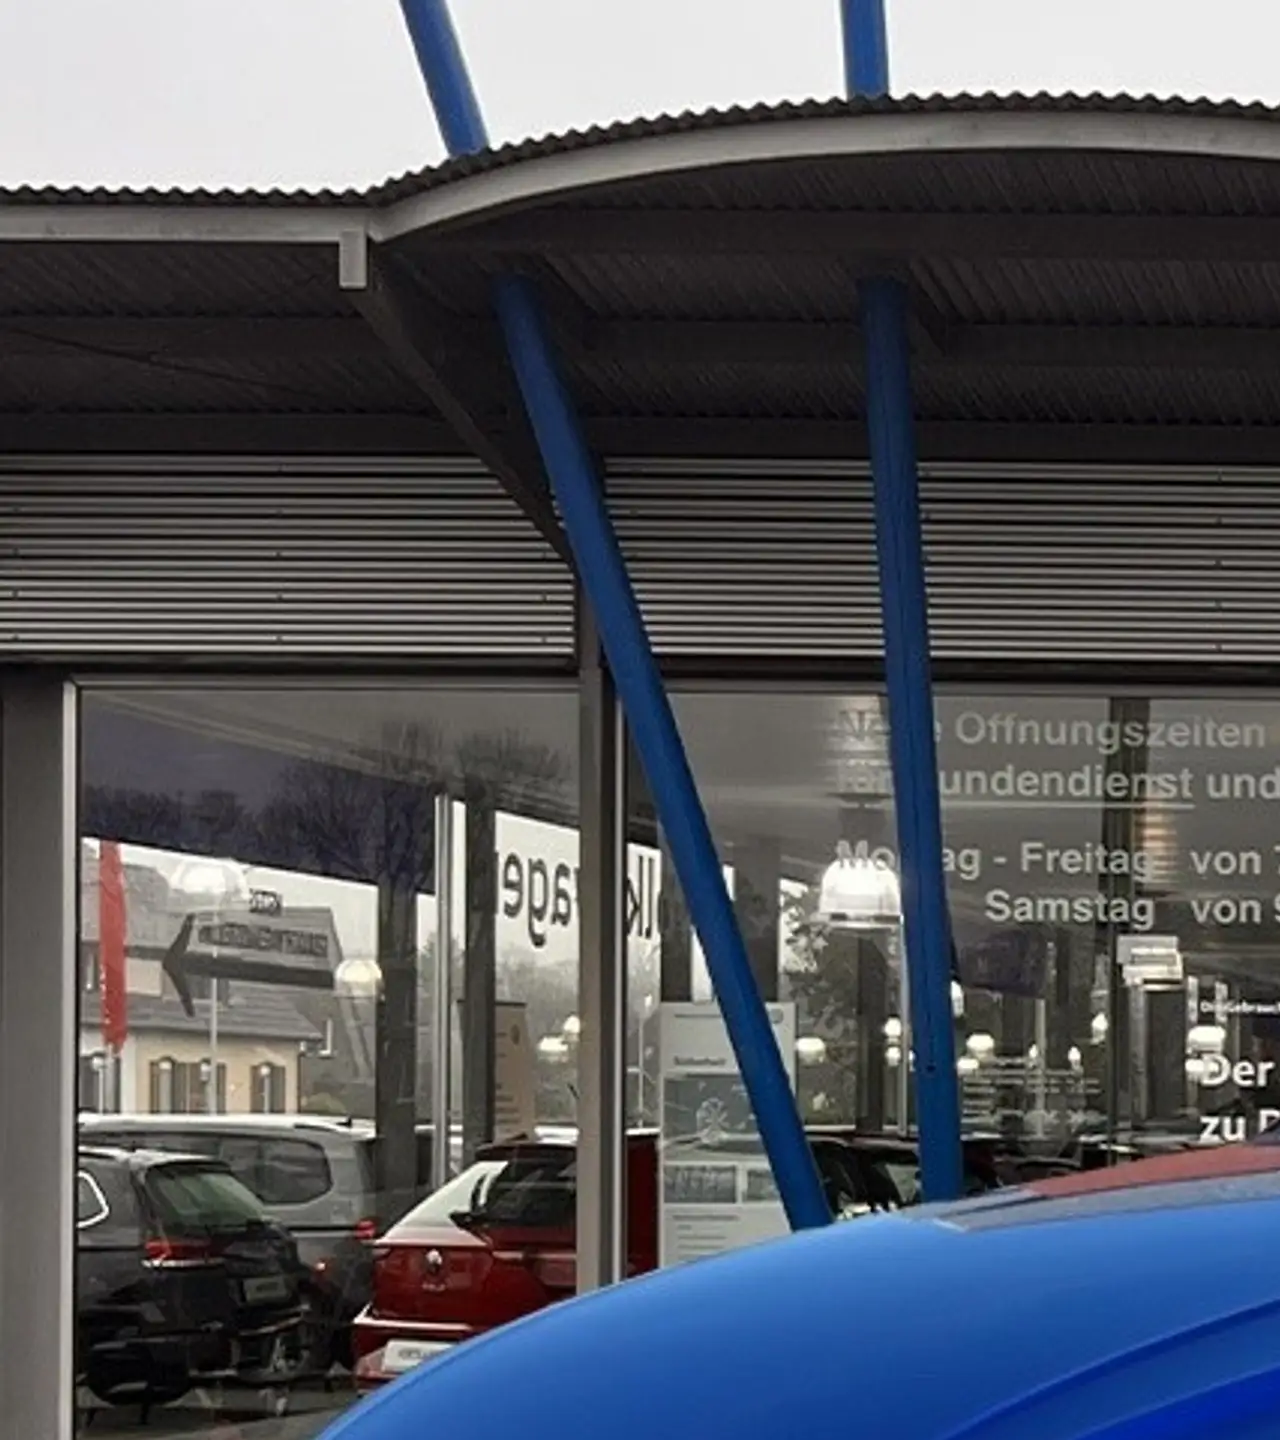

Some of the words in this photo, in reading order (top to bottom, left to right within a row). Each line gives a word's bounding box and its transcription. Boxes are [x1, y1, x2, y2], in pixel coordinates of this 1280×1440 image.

[937, 764, 1194, 797] undendienst
[836, 839, 982, 880] Moag
[1020, 840, 1155, 882] Freitag
[1190, 851, 1263, 878] von
[984, 889, 1155, 929] Samstag
[1190, 898, 1263, 924] von
[1201, 1054, 1275, 1087] Der
[1200, 1115, 1247, 1142] zu
